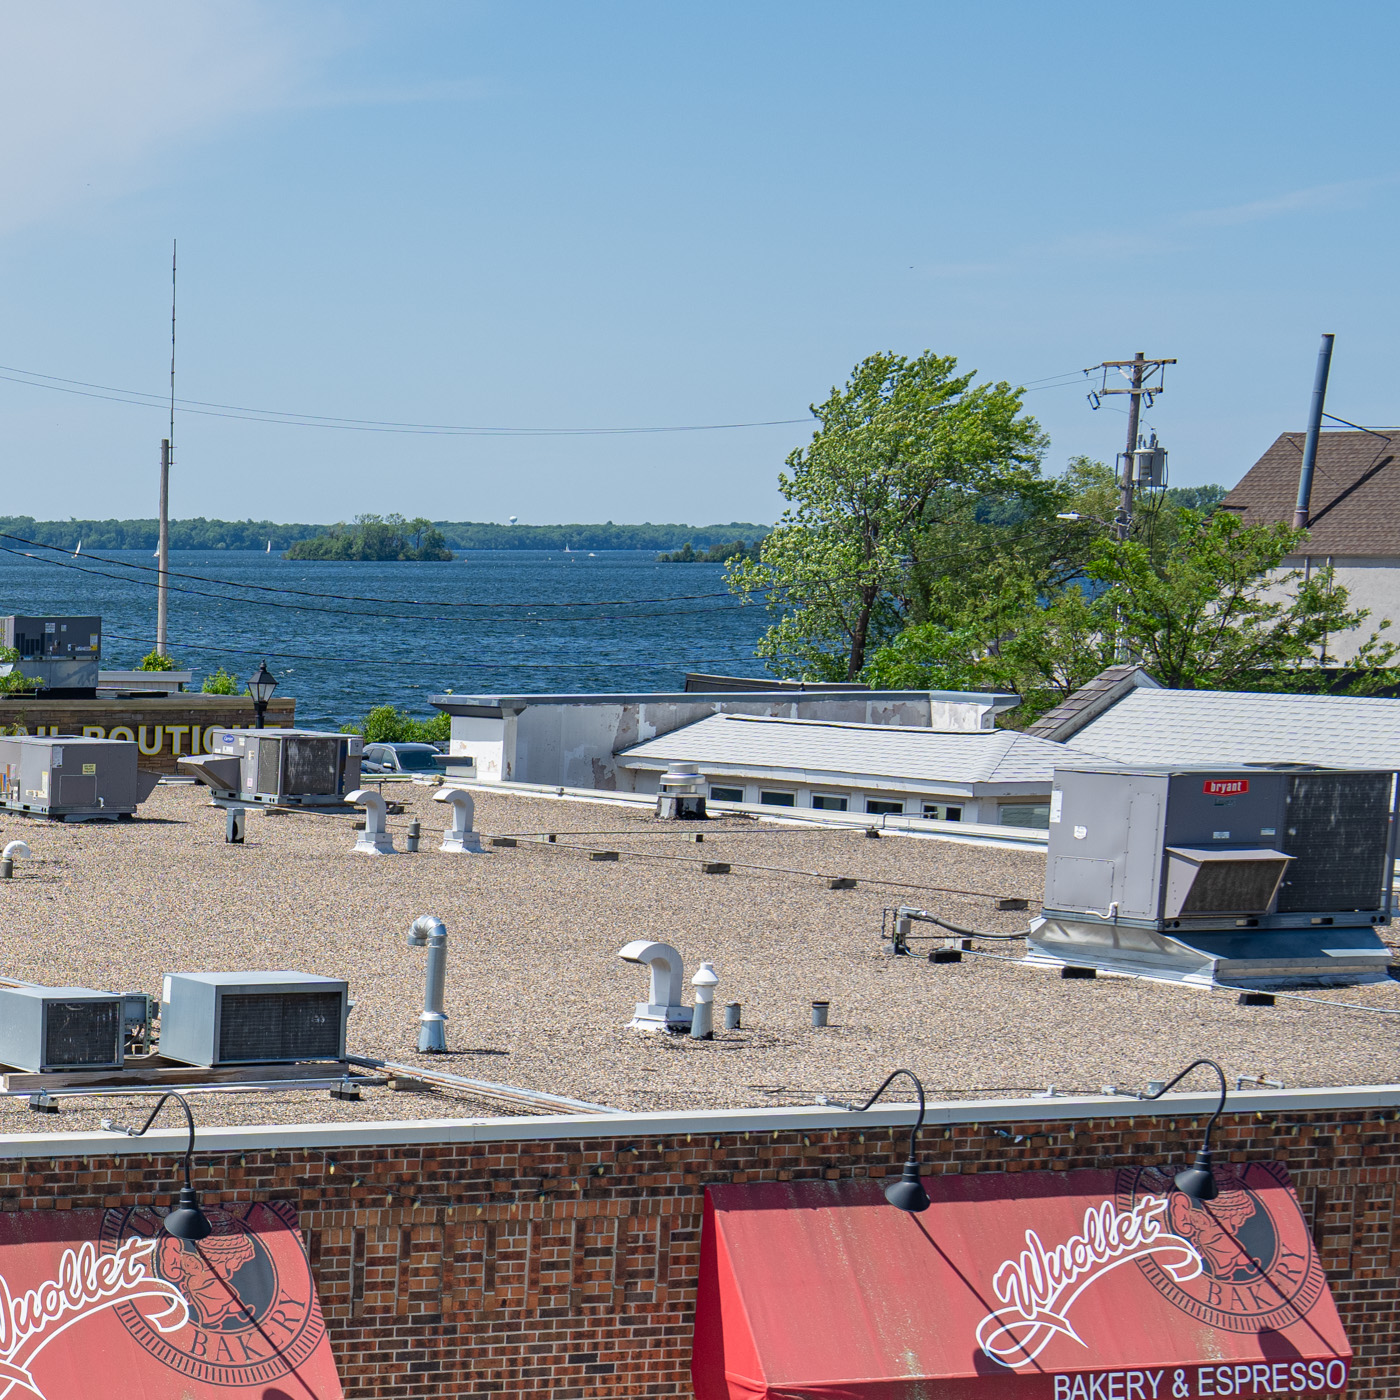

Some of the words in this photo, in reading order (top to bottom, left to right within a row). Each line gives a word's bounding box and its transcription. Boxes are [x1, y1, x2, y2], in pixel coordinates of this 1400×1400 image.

[1210, 782, 1242, 793] bryant
[993, 1195, 1169, 1320] Wuollet
[1207, 1242, 1306, 1312] BAKERY
[191, 1287, 306, 1364] BAKERY
[1171, 1370, 1190, 1398] &
[1197, 1359, 1346, 1396] ESPRESSO
